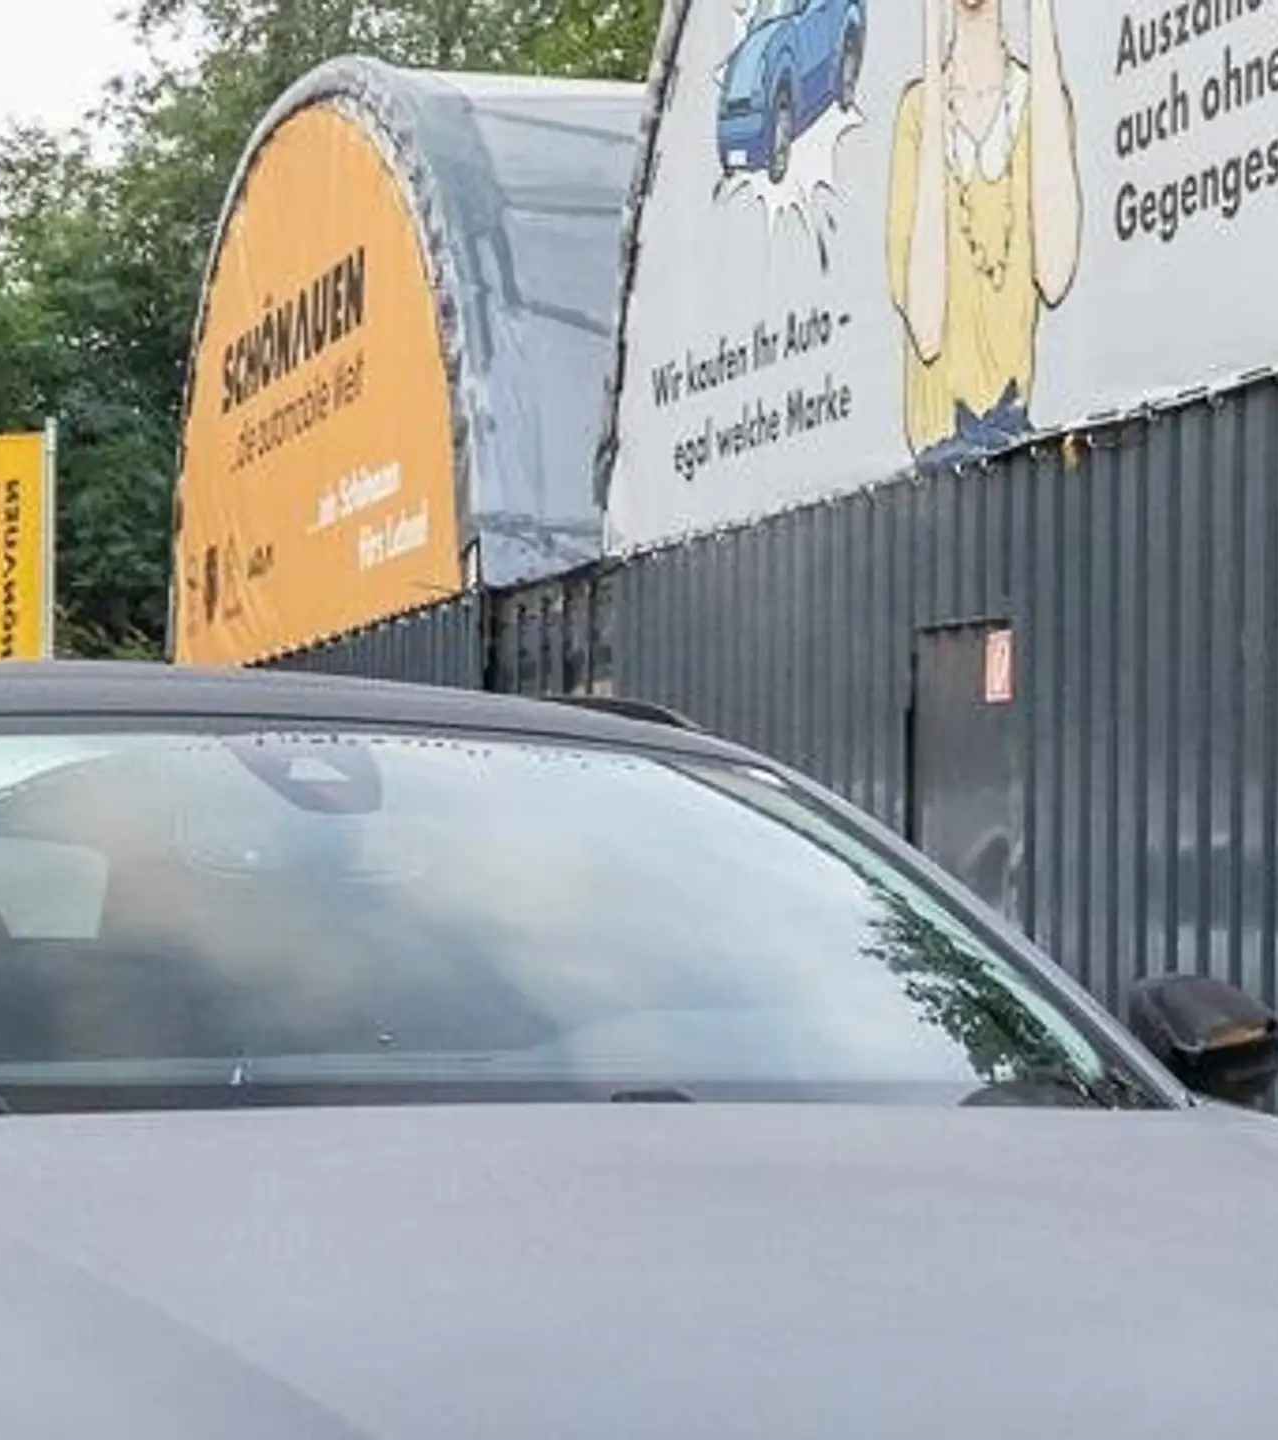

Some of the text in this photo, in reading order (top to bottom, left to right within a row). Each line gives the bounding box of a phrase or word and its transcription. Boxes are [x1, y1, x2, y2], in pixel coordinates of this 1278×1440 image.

[1116, 70, 1189, 159] auch
[222, 245, 365, 413] SCHÖNAUEN
[651, 360, 683, 408] Wir
[686, 336, 747, 398] kaufen
[753, 319, 778, 371] Ihr
[783, 307, 832, 359] Auto
[674, 372, 852, 482] egal welche Marke
